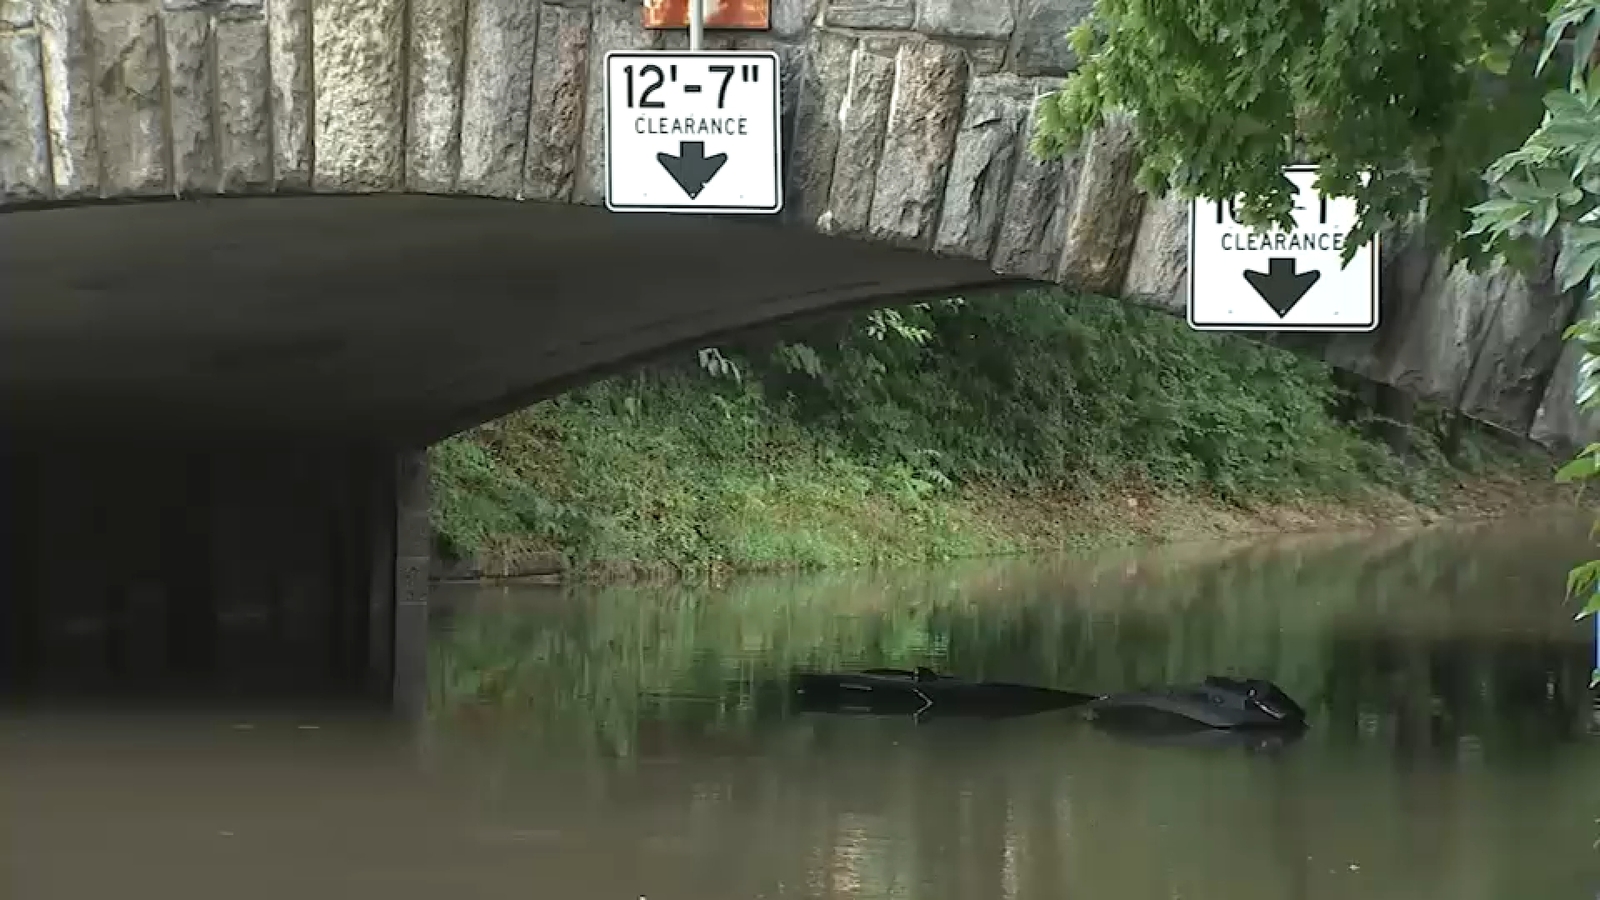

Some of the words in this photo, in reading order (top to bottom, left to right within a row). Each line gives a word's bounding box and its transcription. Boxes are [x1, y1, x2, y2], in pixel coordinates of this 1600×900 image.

[623, 64, 759, 109] 12'-7"
[634, 117, 748, 135] CLEARANCE
[1221, 232, 1344, 251] CLEARANCE
